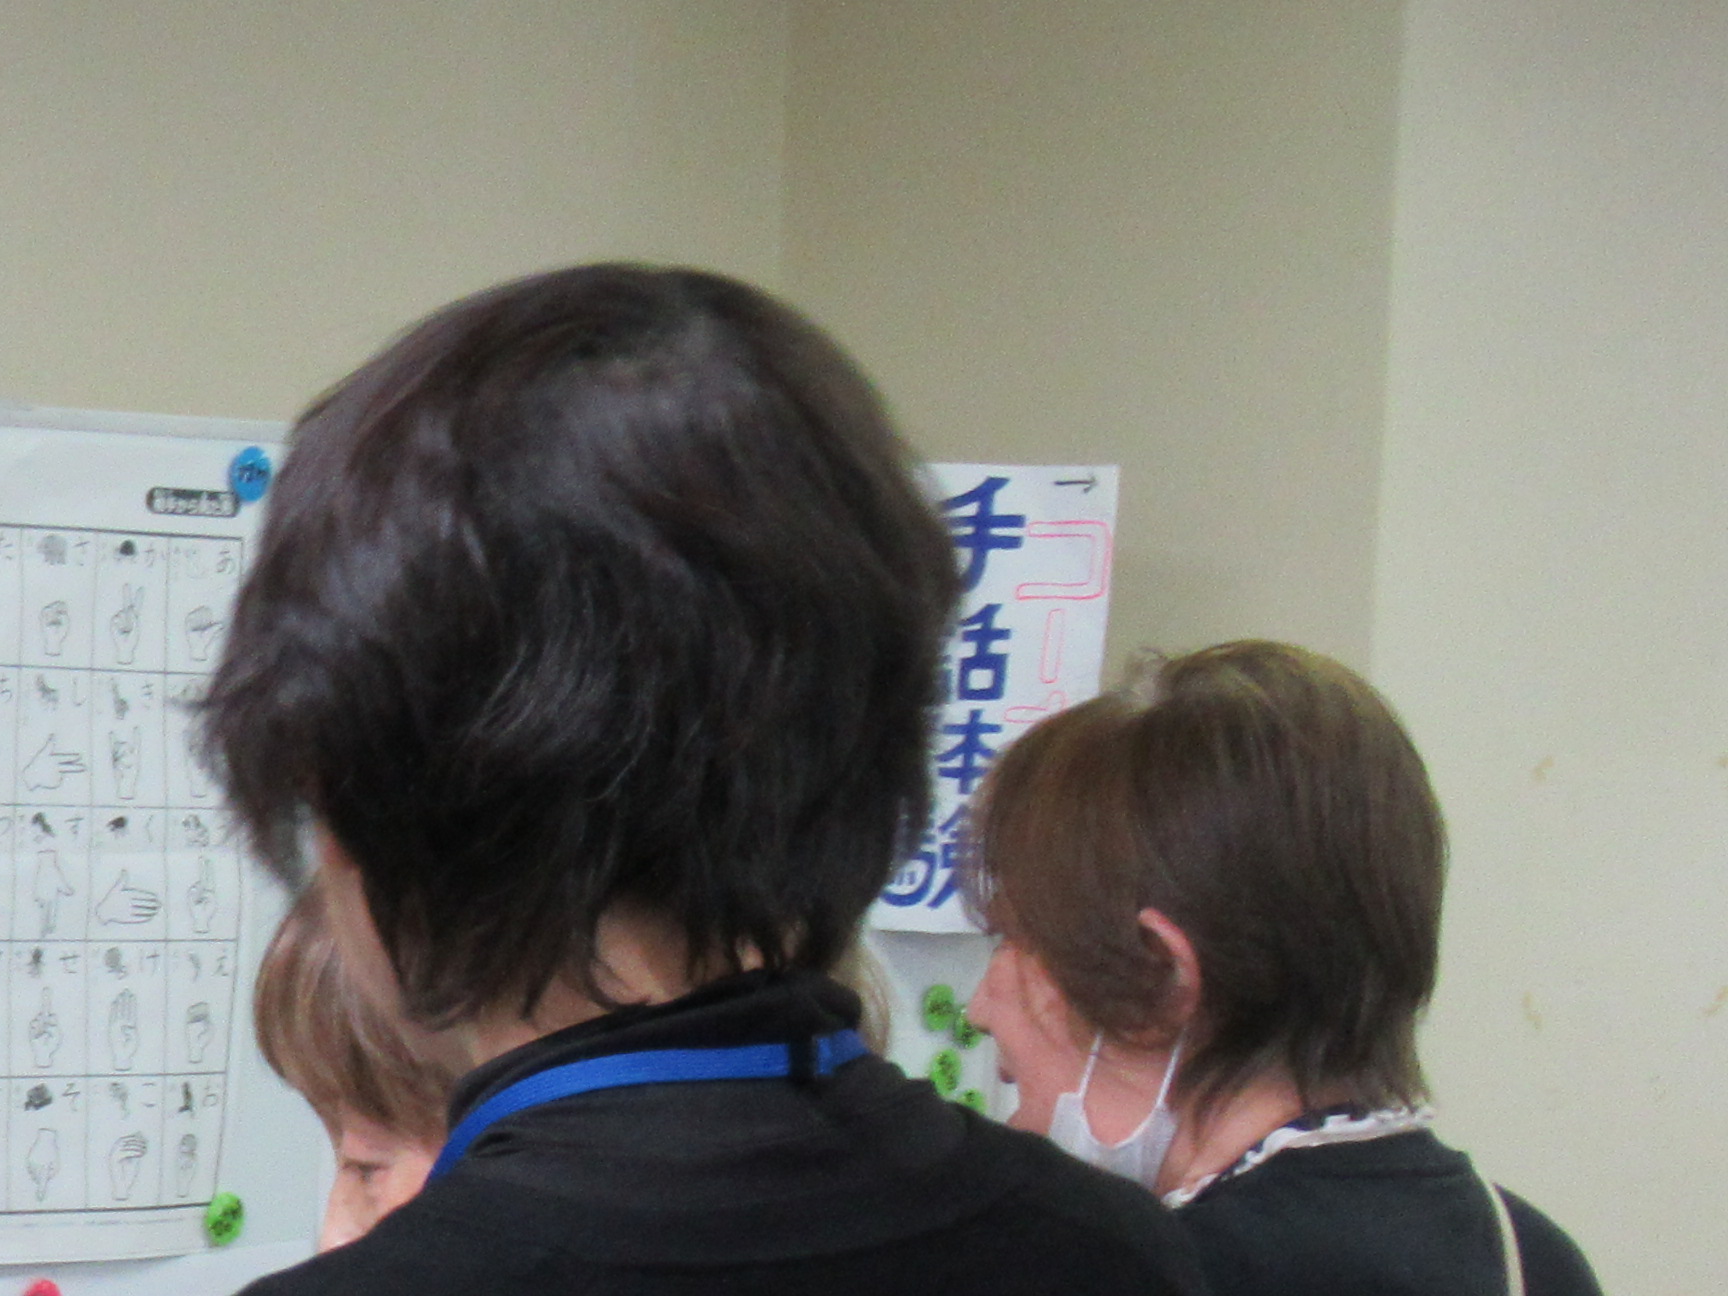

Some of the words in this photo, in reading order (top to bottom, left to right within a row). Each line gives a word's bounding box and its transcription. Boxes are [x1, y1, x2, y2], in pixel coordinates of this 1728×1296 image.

[72, 674, 87, 707] し
[65, 813, 85, 841] す
[58, 950, 80, 976] せ
[62, 1081, 82, 1113] そ
